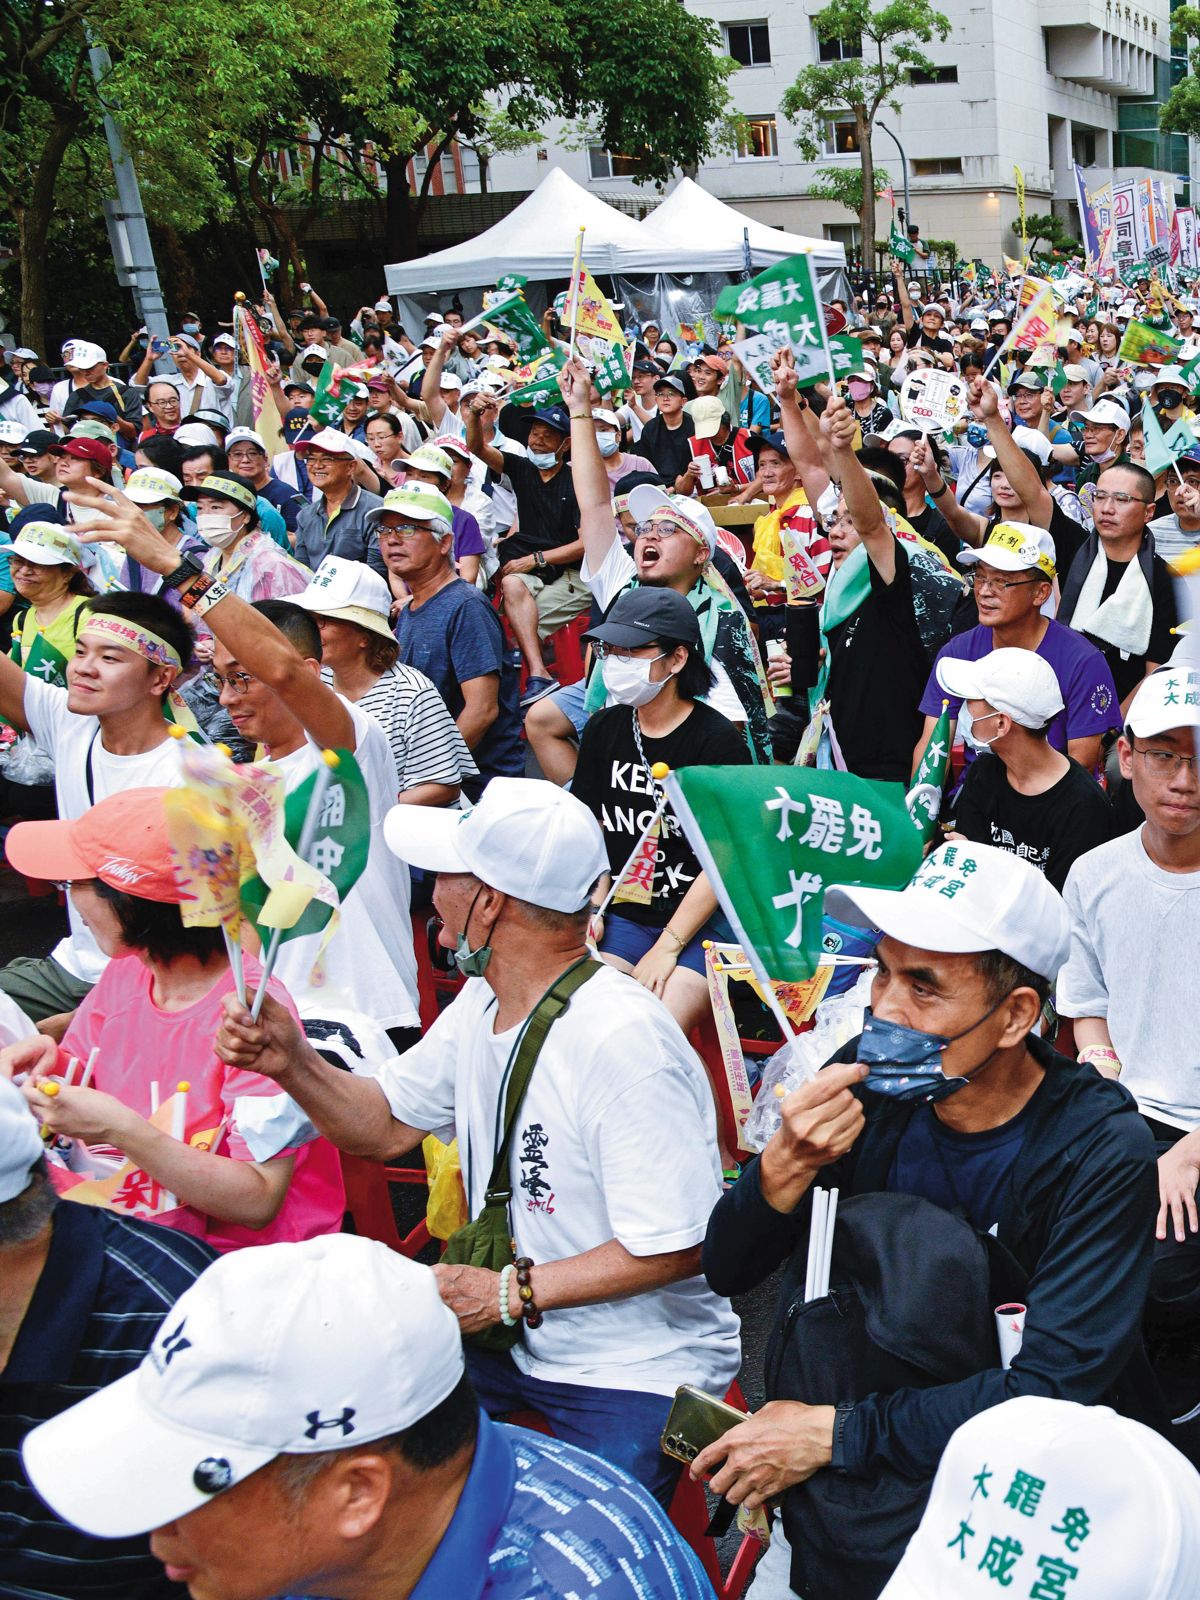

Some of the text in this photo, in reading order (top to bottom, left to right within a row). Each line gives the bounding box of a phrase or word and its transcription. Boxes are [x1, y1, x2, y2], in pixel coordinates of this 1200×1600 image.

[1164, 691, 1200, 707] 大成
[1165, 672, 1200, 691] 大罷
[610, 760, 662, 797] KEE
[764, 786, 883, 861] 大罷免
[96, 855, 156, 885] TAIWAN
[970, 1462, 1093, 1554] 大罷免
[946, 1509, 1081, 1600] 大成宮
